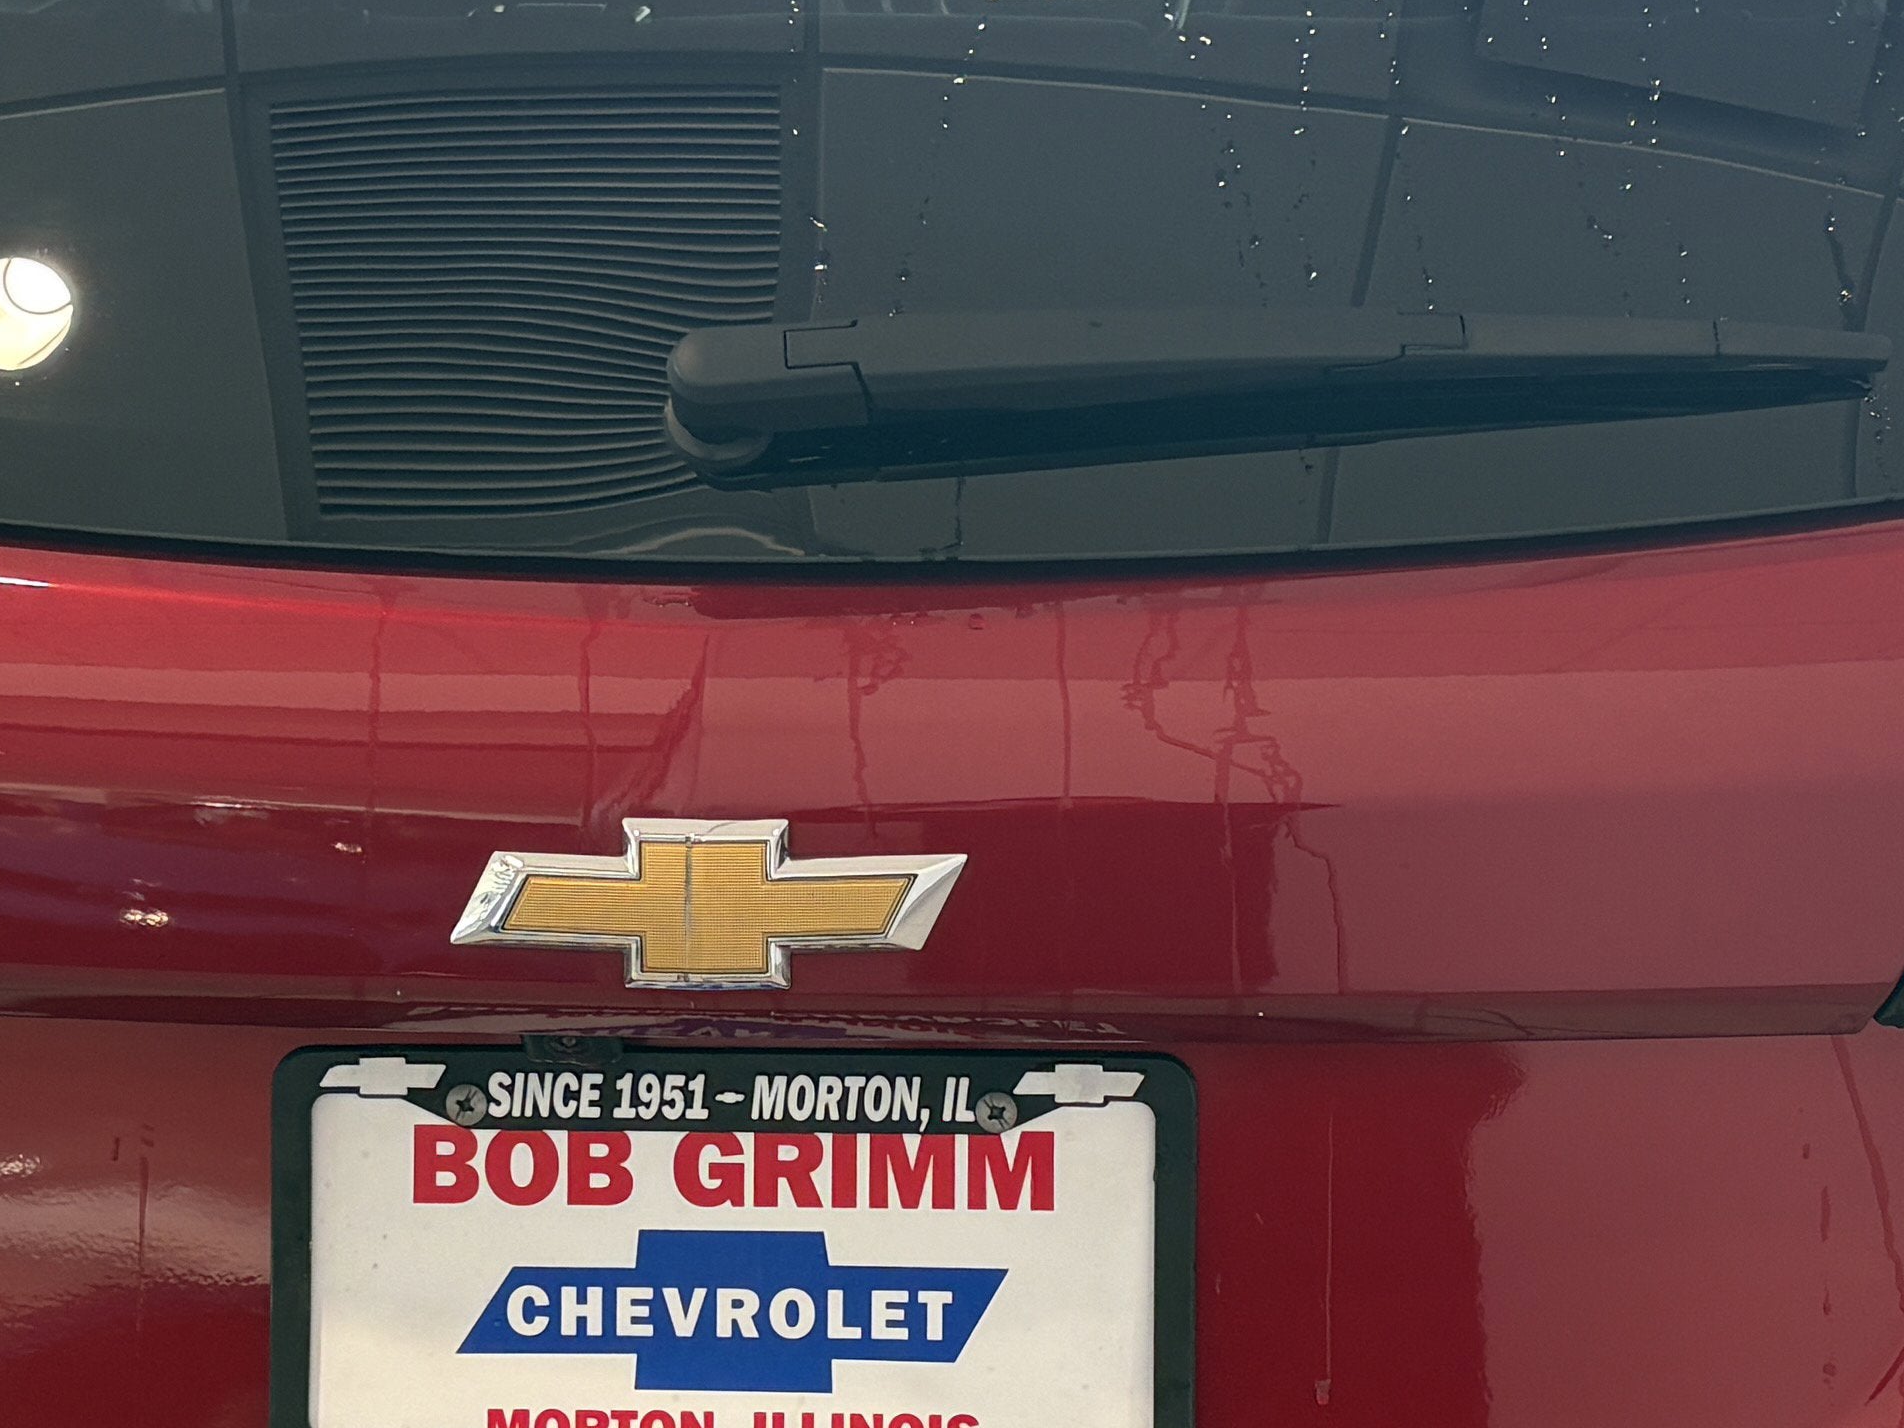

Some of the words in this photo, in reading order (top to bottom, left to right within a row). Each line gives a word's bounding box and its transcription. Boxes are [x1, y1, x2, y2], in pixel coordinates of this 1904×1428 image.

[488, 1072, 603, 1120] SINCE
[612, 1073, 709, 1120] 1951
[750, 1075, 931, 1132] MORTON,
[942, 1077, 977, 1124] IL
[412, 1125, 634, 1205] BOB
[673, 1131, 1056, 1211] GRIMM
[505, 1284, 954, 1342] CHEVROLET
